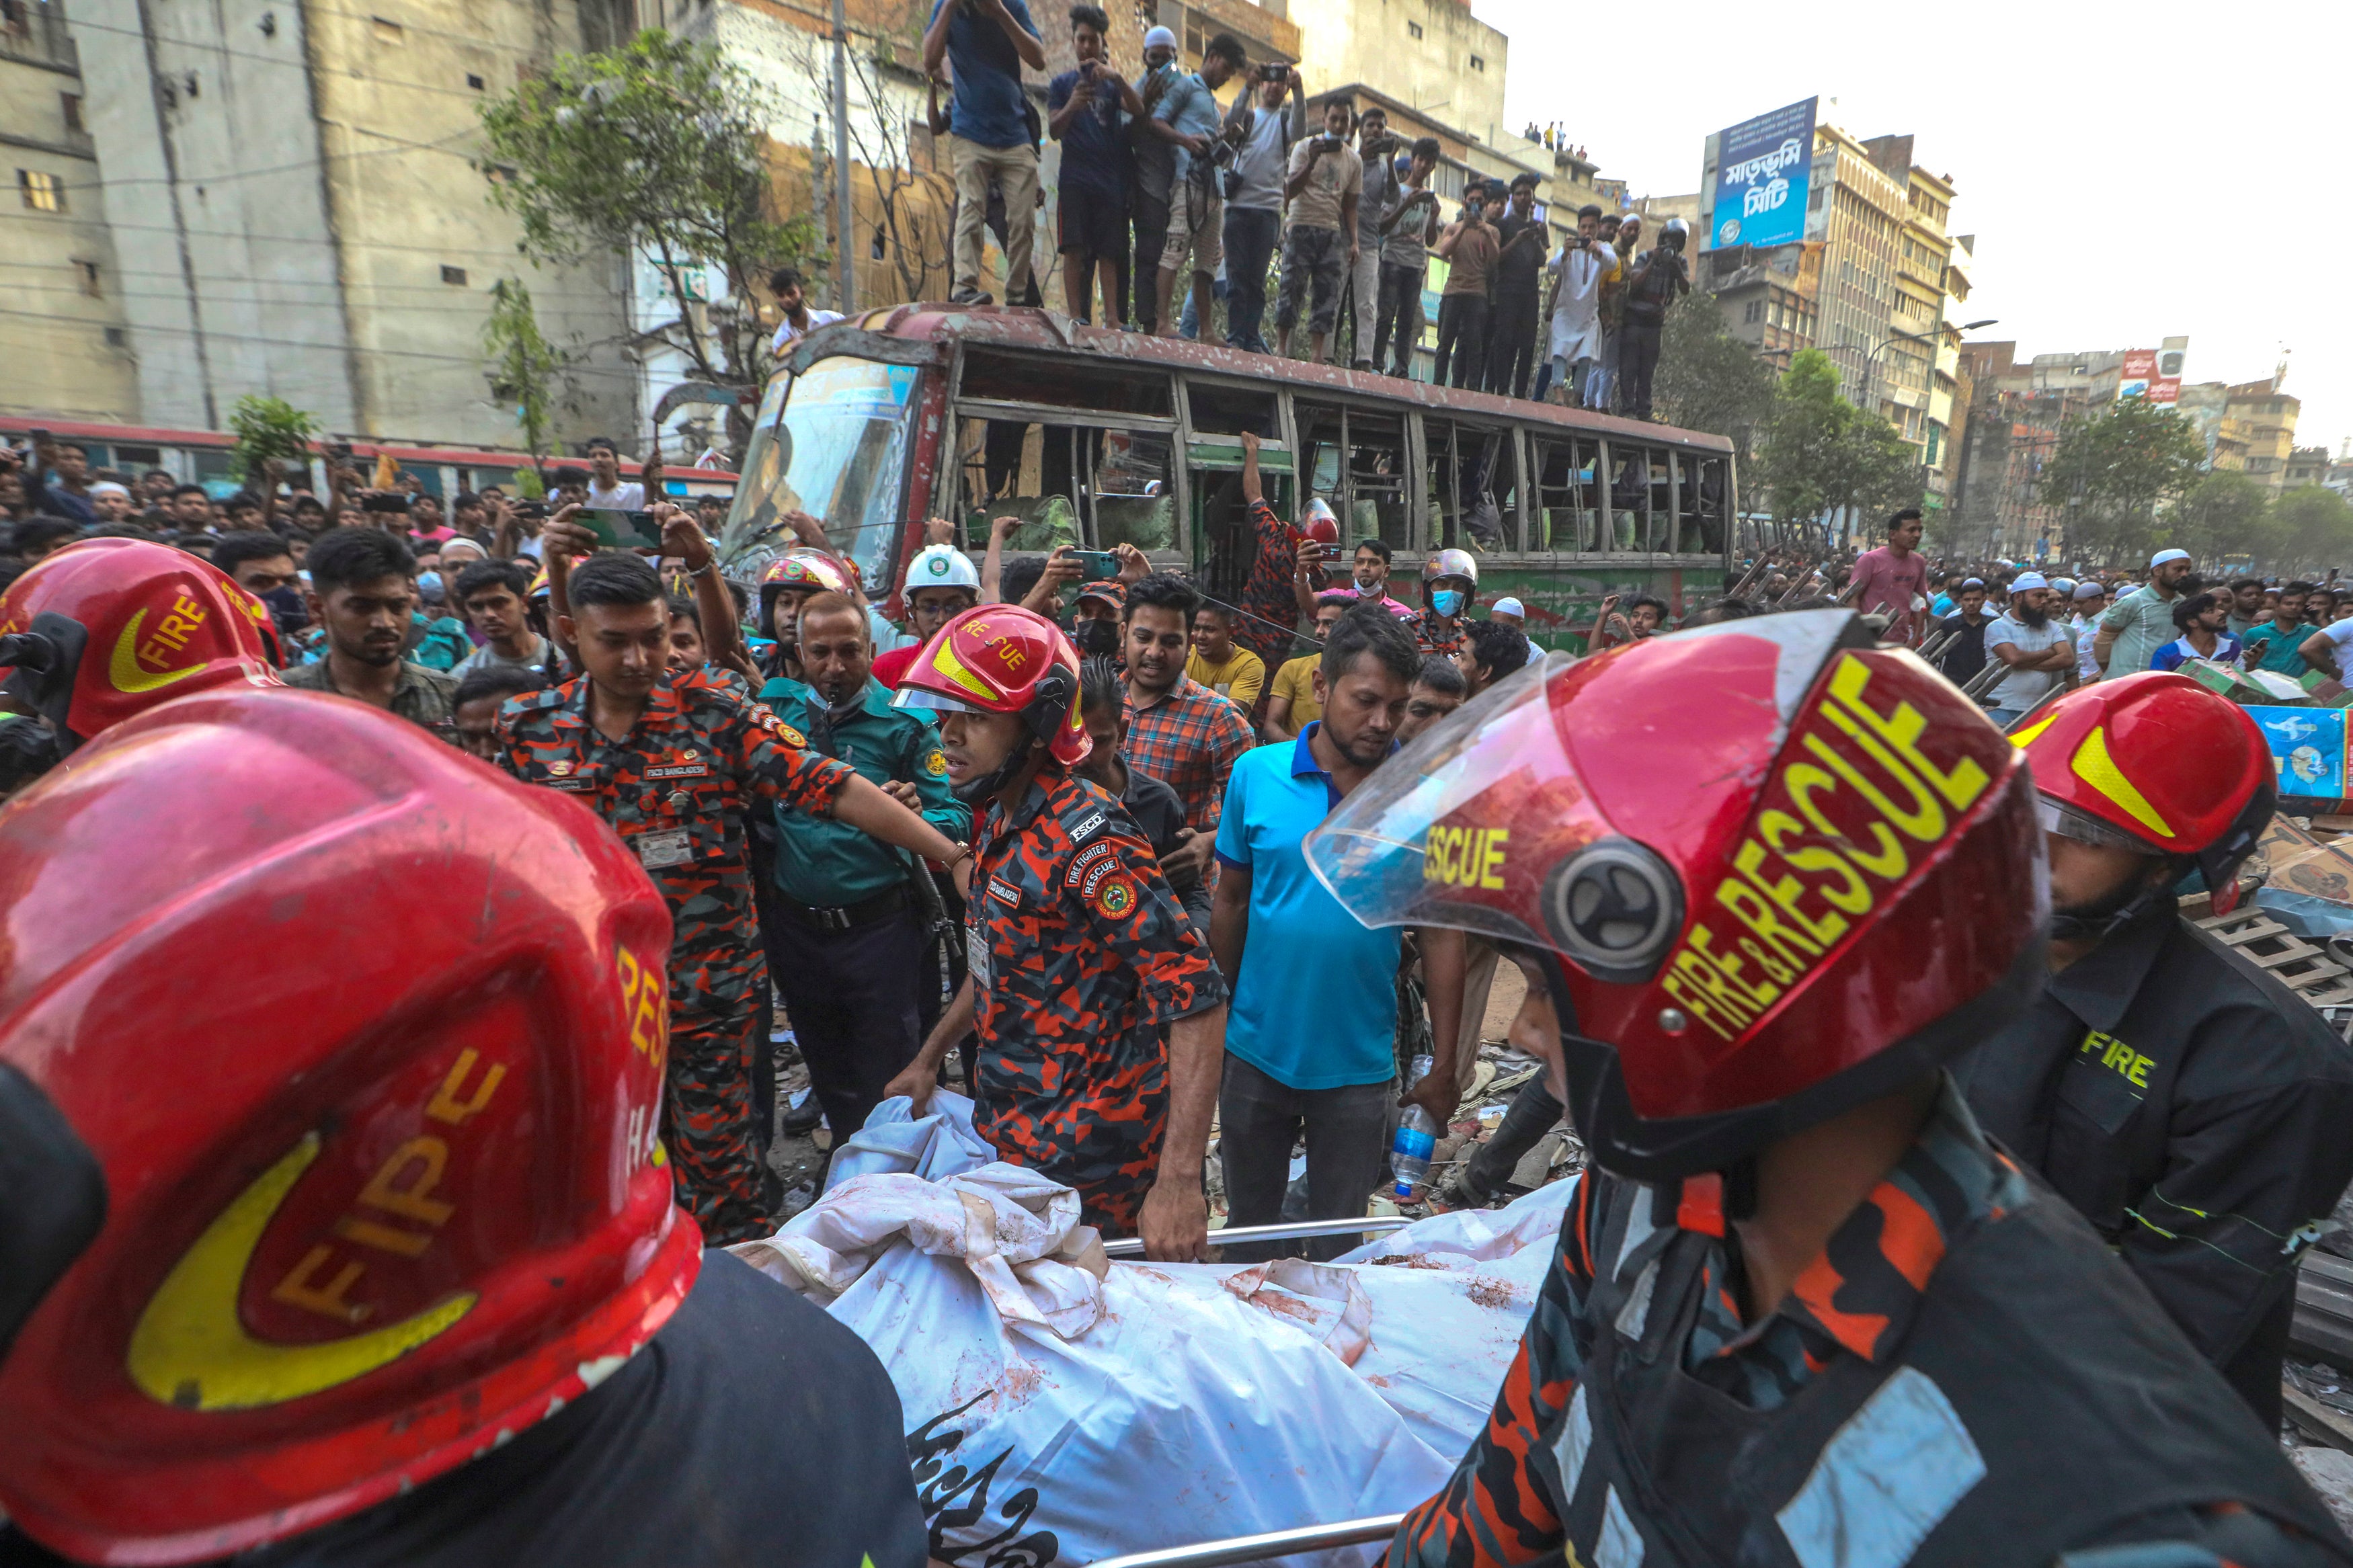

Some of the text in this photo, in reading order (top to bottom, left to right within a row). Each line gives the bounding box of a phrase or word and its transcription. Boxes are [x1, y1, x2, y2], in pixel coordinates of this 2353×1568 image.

[1725, 138, 1802, 185] মাতৃভূমি
[1743, 177, 1790, 218] সিটি
[138, 595, 208, 669] FIRE
[1072, 815, 1103, 839] FSCD
[1069, 865, 1082, 884] FIRE
[1077, 843, 1107, 867] FIGHTER
[1085, 860, 1116, 895] RESCUE
[1423, 826, 1509, 890] ESCUE
[2081, 1029, 2157, 1089] FIRE
